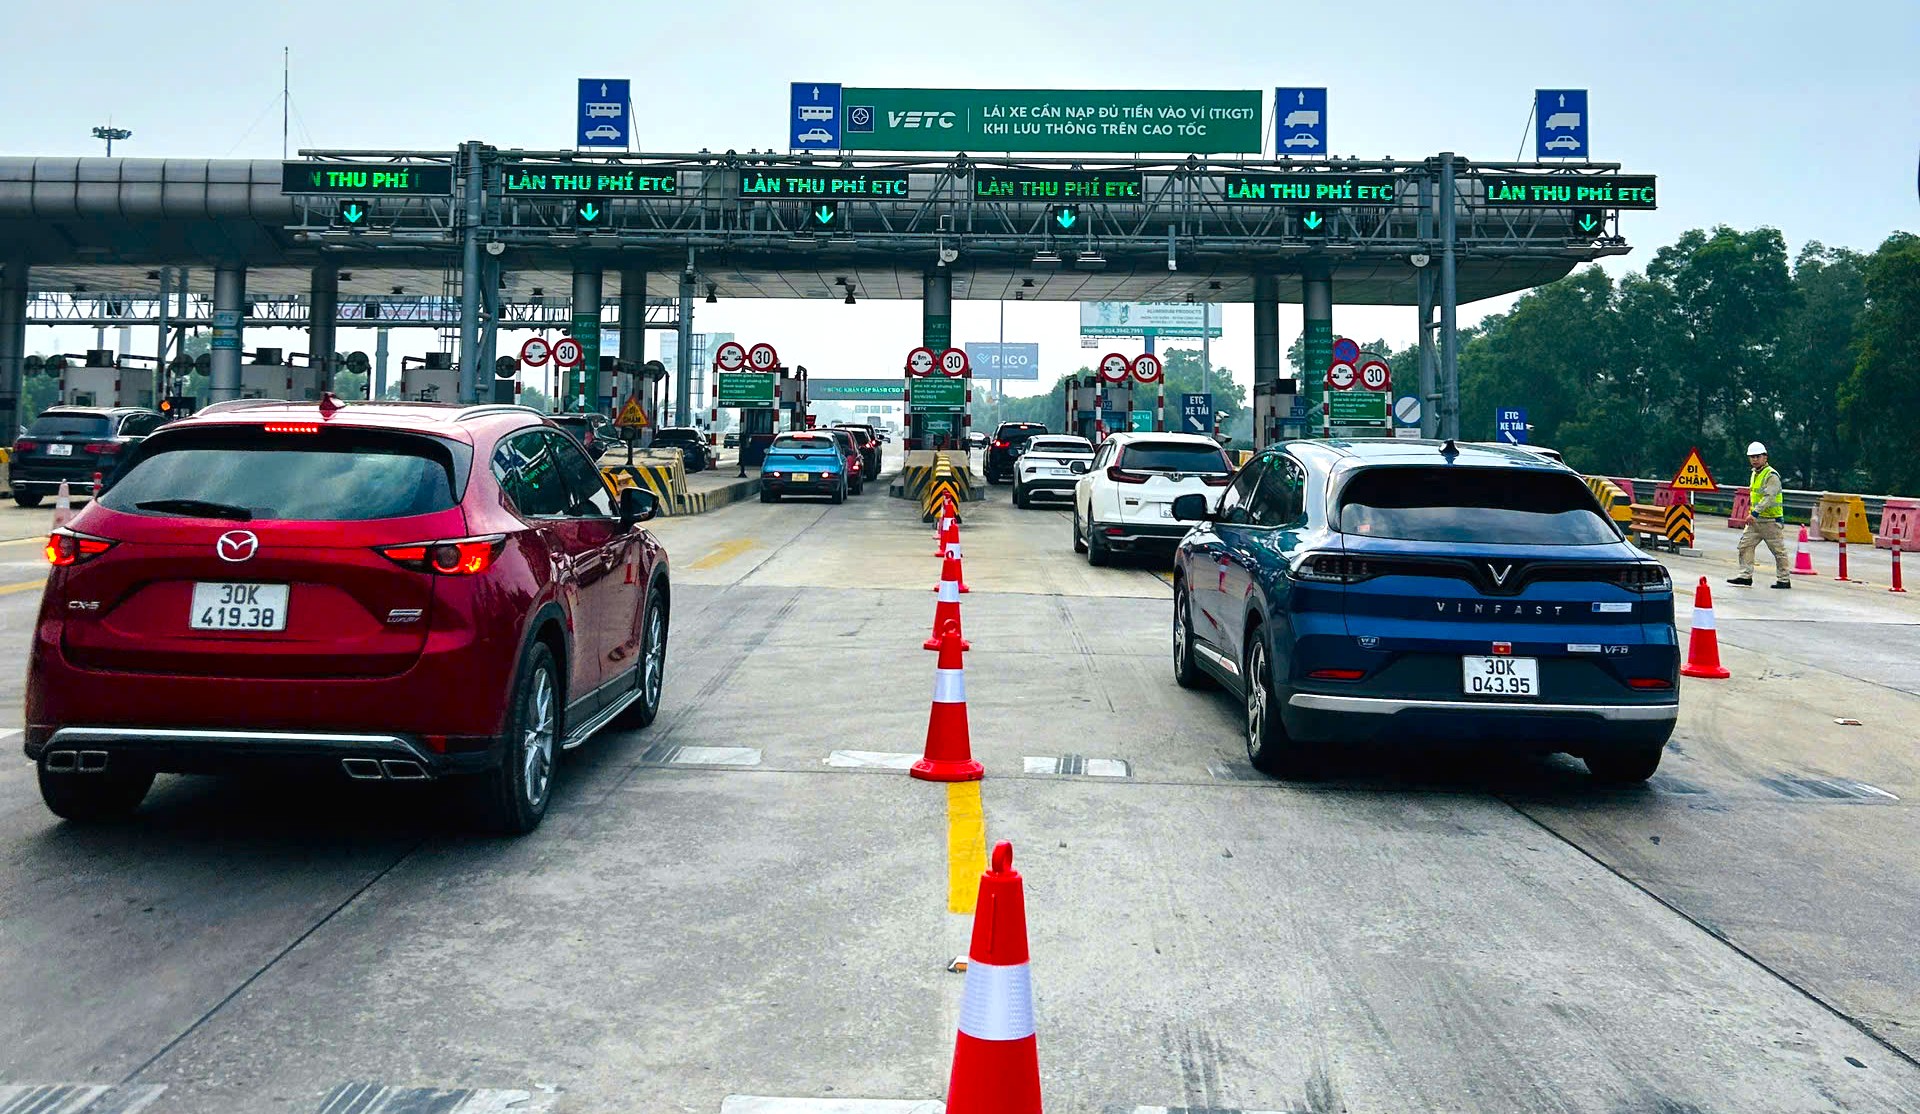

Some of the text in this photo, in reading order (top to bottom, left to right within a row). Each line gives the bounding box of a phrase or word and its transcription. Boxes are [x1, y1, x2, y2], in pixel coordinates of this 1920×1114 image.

[887, 111, 957, 129] VETC
[984, 105, 1005, 118] LÁI
[1009, 106, 1027, 118] XE
[1065, 106, 1095, 123] NẠP
[1098, 104, 1119, 118] ĐỦ
[1157, 105, 1187, 119] VÀO
[1189, 106, 1206, 119] VÍ
[1208, 107, 1255, 121] (TKGT)
[983, 120, 1206, 137] KHI LƯU THÔNG TRÊN CAO TỐC
[326, 171, 367, 188] THU
[372, 167, 409, 189] PHÍ
[507, 170, 675, 193] LÀN THU PHÍ ETC
[743, 173, 907, 196] LÀN THU PHÍ ETC
[976, 176, 1140, 198] LÀN THU PHÍ ETC
[1227, 178, 1393, 203] LÀN THU PHÍ ETC
[1487, 181, 1655, 206] LÀN THU PHÍ ETC
[560, 345, 575, 360] 30
[755, 350, 770, 365] 30
[946, 355, 961, 369] 30
[1138, 361, 1154, 376] 30
[1367, 368, 1383, 383] 30
[1190, 396, 1204, 405] ETC
[1185, 403, 1209, 415] XE TẢI
[1504, 411, 1519, 420] ETC
[1500, 422, 1510, 431] XE
[1687, 464, 1698, 474] ĐI
[1678, 474, 1708, 487] CHẬM
[220, 584, 261, 605] 30K
[69, 600, 100, 610] CX-5
[1436, 602, 1563, 616] VINFAST
[201, 606, 275, 628] 419.38
[1485, 659, 1516, 676] 30K
[1472, 676, 1530, 694] 043.95
